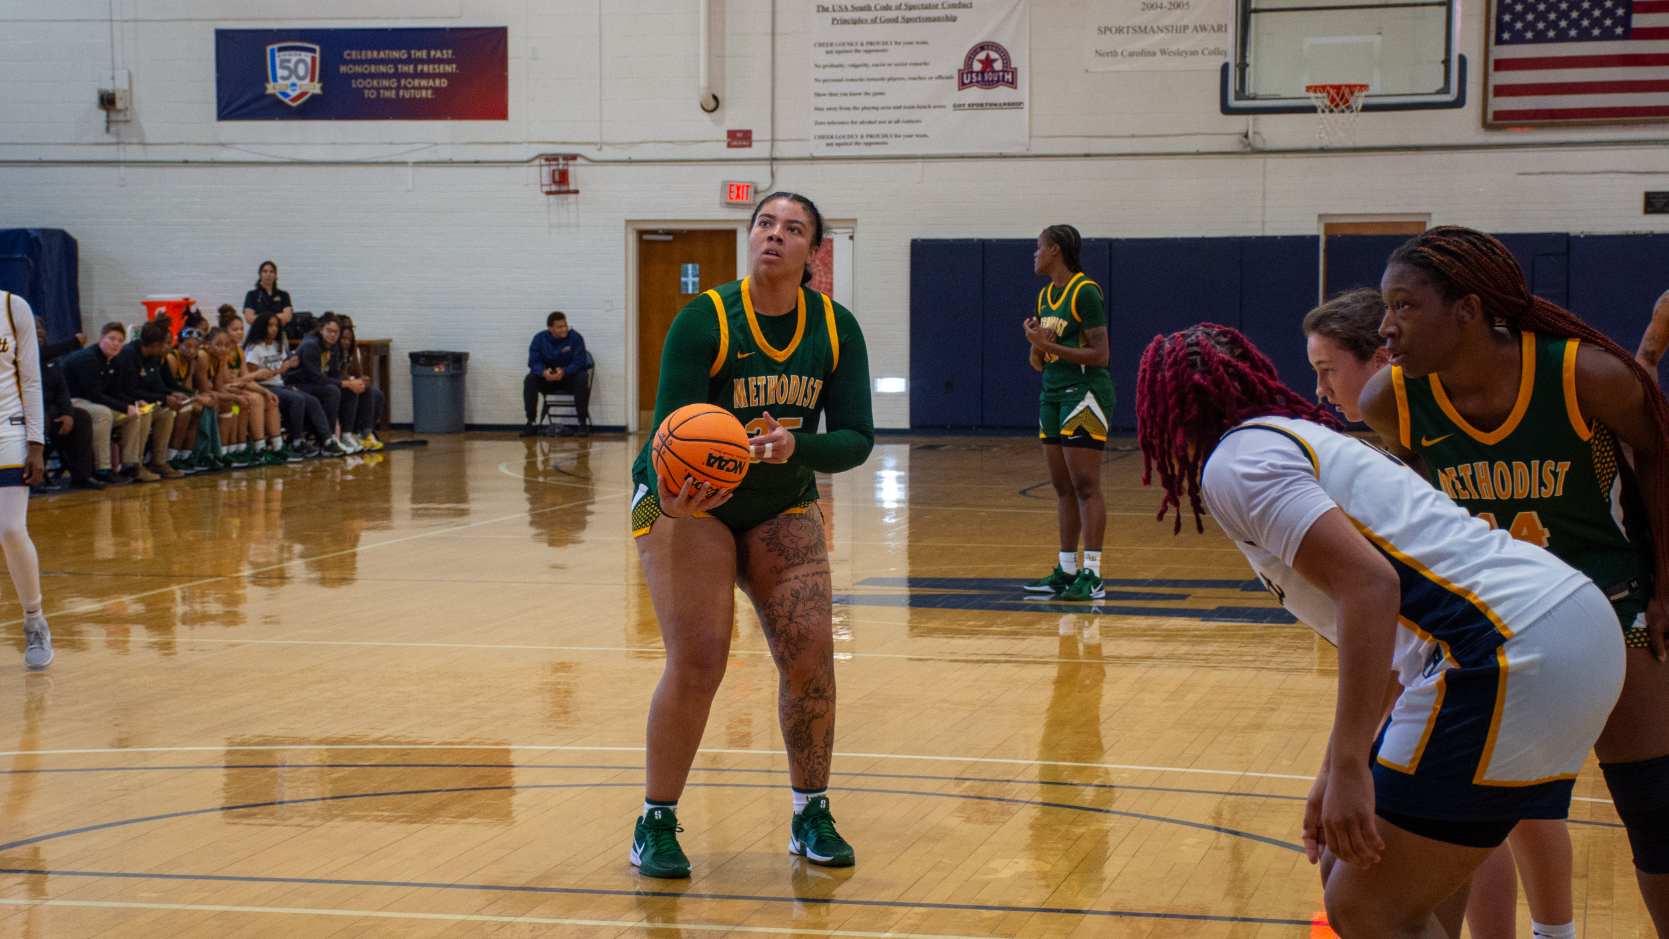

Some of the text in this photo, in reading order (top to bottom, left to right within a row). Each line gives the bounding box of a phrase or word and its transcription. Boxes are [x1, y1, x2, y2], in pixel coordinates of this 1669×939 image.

[904, 2, 939, 11] Spectator
[1140, 2, 1190, 11] 2004-2005
[831, 17, 868, 25] Principles
[901, 14, 957, 23] Sportsmanship
[1097, 25, 1189, 35] SPORTSMANSHIP
[343, 50, 455, 59] CELEBRATING THE PAST.
[1095, 50, 1118, 58] North
[1121, 48, 1156, 57] Carolina
[1159, 48, 1199, 58] Wesleyan
[279, 58, 309, 81] 50
[339, 64, 460, 73] HONORING THE PRESENT.
[352, 78, 448, 88] LOOKING FORWARD
[963, 72, 1012, 84] USA SOUTH
[364, 89, 436, 98] TO THE FUTURE.
[728, 184, 750, 201] EXIT
[734, 374, 823, 409] METHODIST
[706, 452, 746, 474] NCAA
[1438, 460, 1571, 500] METHODIST
